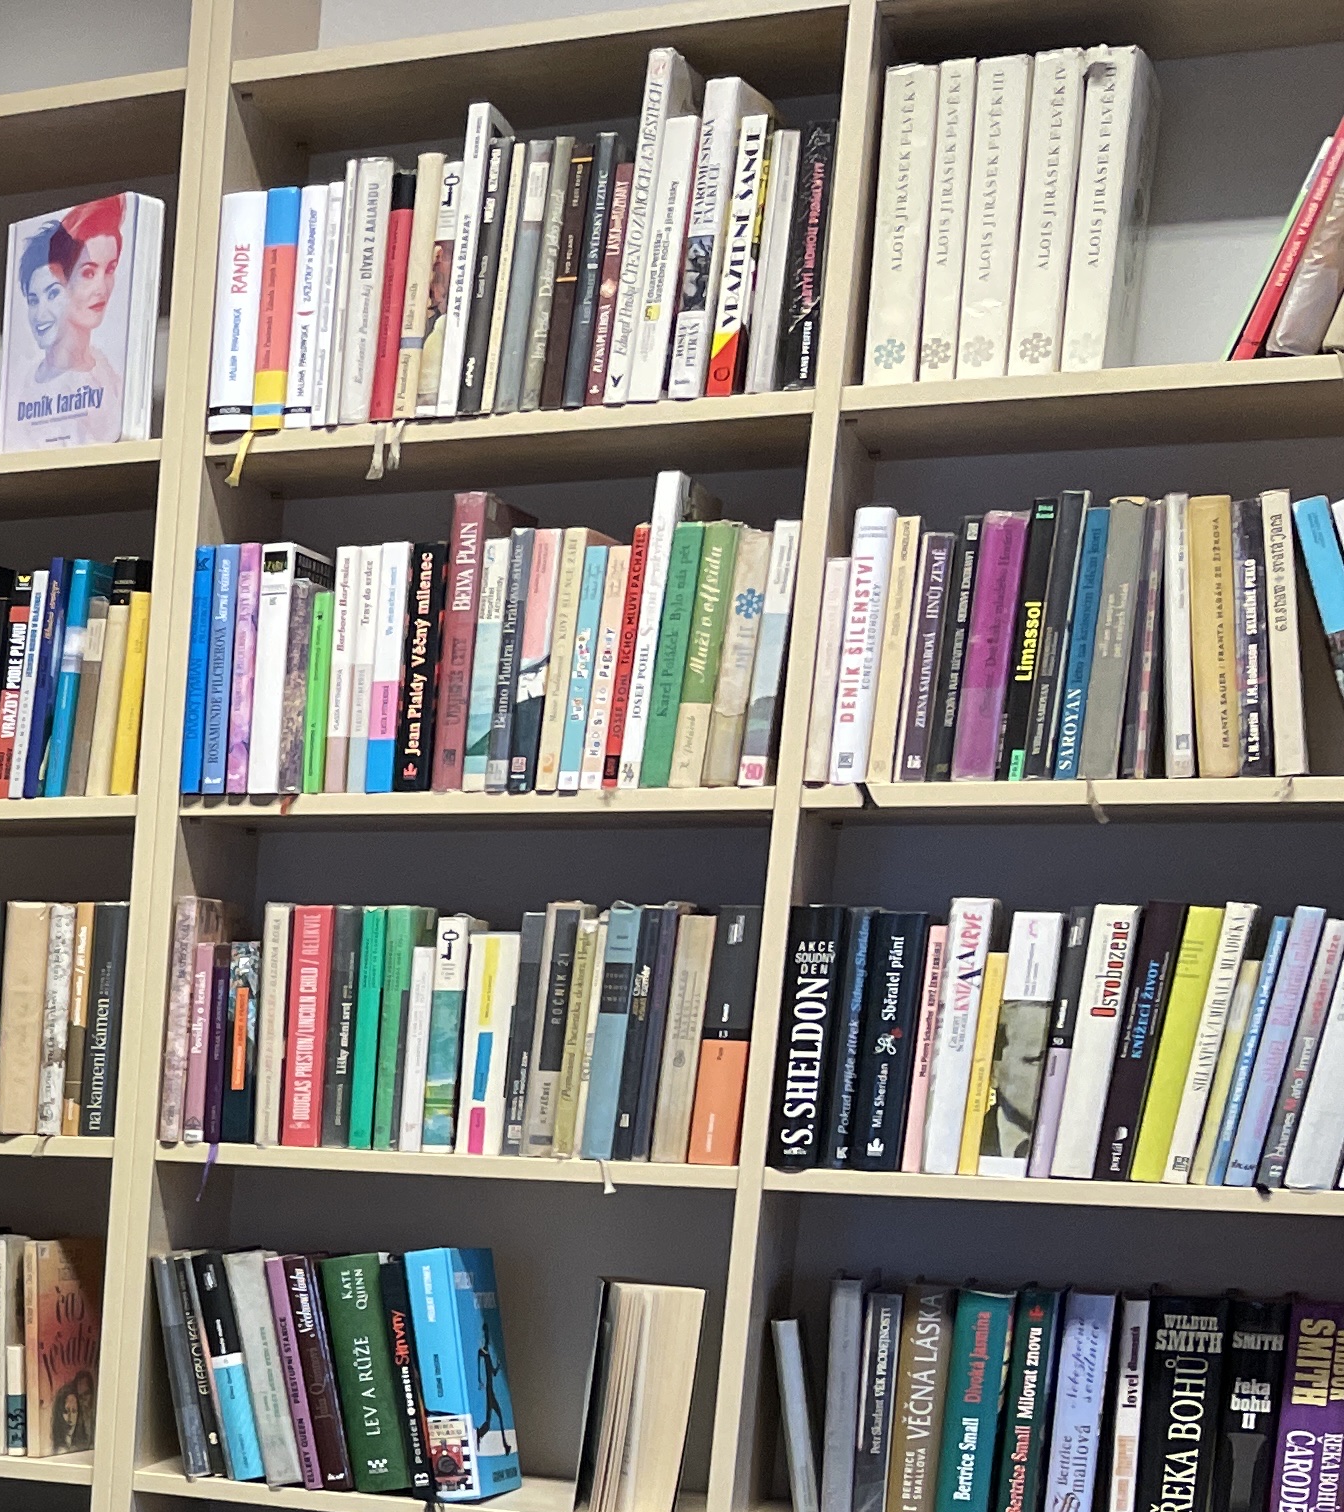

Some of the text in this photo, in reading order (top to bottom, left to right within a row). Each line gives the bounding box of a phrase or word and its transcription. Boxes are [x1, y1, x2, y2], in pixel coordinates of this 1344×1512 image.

[722, 129, 762, 328] VRAŽEDNÉ ŠANCE
[891, 150, 911, 272] ALOIS JIRÁSEK
[979, 155, 999, 282] ALOIS JIRÁSEK
[232, 242, 251, 296] RANDE
[452, 521, 478, 612] BELVA PLAIN
[0, 623, 27, 738] VRAŽDY PODLE PLÁNU
[405, 552, 433, 756] Jean Plaidy Věčný milenec
[840, 557, 874, 723] DENÍK ŠÍLENSTVÍ
[1014, 601, 1042, 682] Limassol
[1059, 689, 1081, 770] SAROYAN
[798, 941, 835, 953] AKCE
[87, 999, 110, 1132] na kameni kámen
[293, 913, 321, 1121] DOUGLAS PRESTON/LINCOLN CHILD RELIKVIE
[788, 976, 829, 1145] S. SHELDON
[341, 1270, 353, 1300] KATE
[356, 1268, 368, 1310] QUINN
[1164, 1314, 1218, 1331] WILBUR
[353, 1335, 381, 1437] LEV A RŮŽE
[906, 1294, 940, 1440] VĚČNÁ LÁSKA
[1155, 1331, 1222, 1353] SMITH
[1165, 1356, 1208, 1441] BOHŮ
